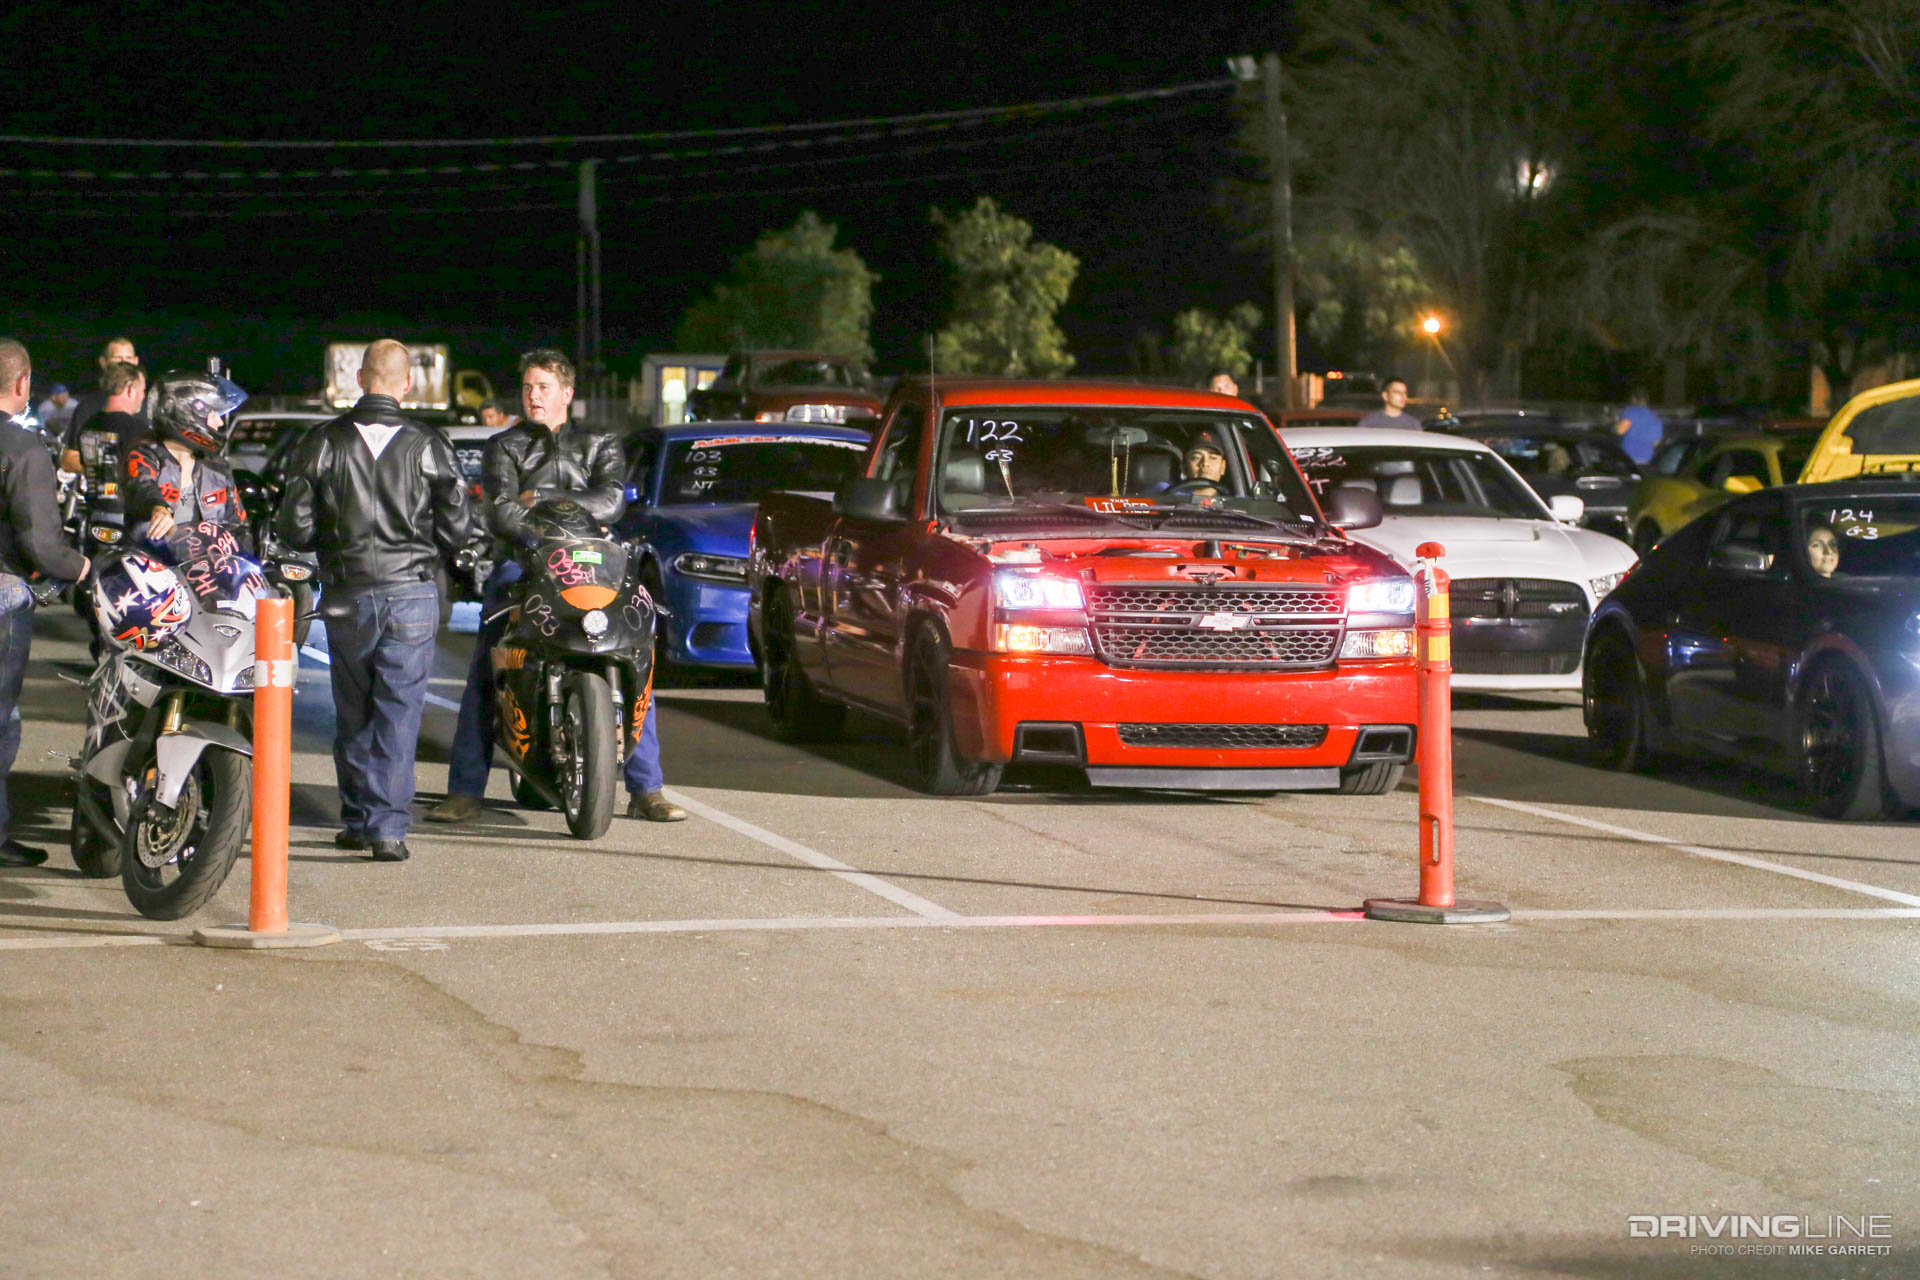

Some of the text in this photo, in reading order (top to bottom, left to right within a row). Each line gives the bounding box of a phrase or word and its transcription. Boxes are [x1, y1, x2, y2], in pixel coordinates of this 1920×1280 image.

[966, 419, 1024, 442] 122
[684, 450, 722, 463] 103
[985, 449, 1015, 462] G3
[692, 480, 715, 490] NT
[1093, 502, 1121, 514] LIL
[1830, 508, 1874, 524] 124
[1845, 525, 1879, 540] G3
[524, 594, 561, 637] 033
